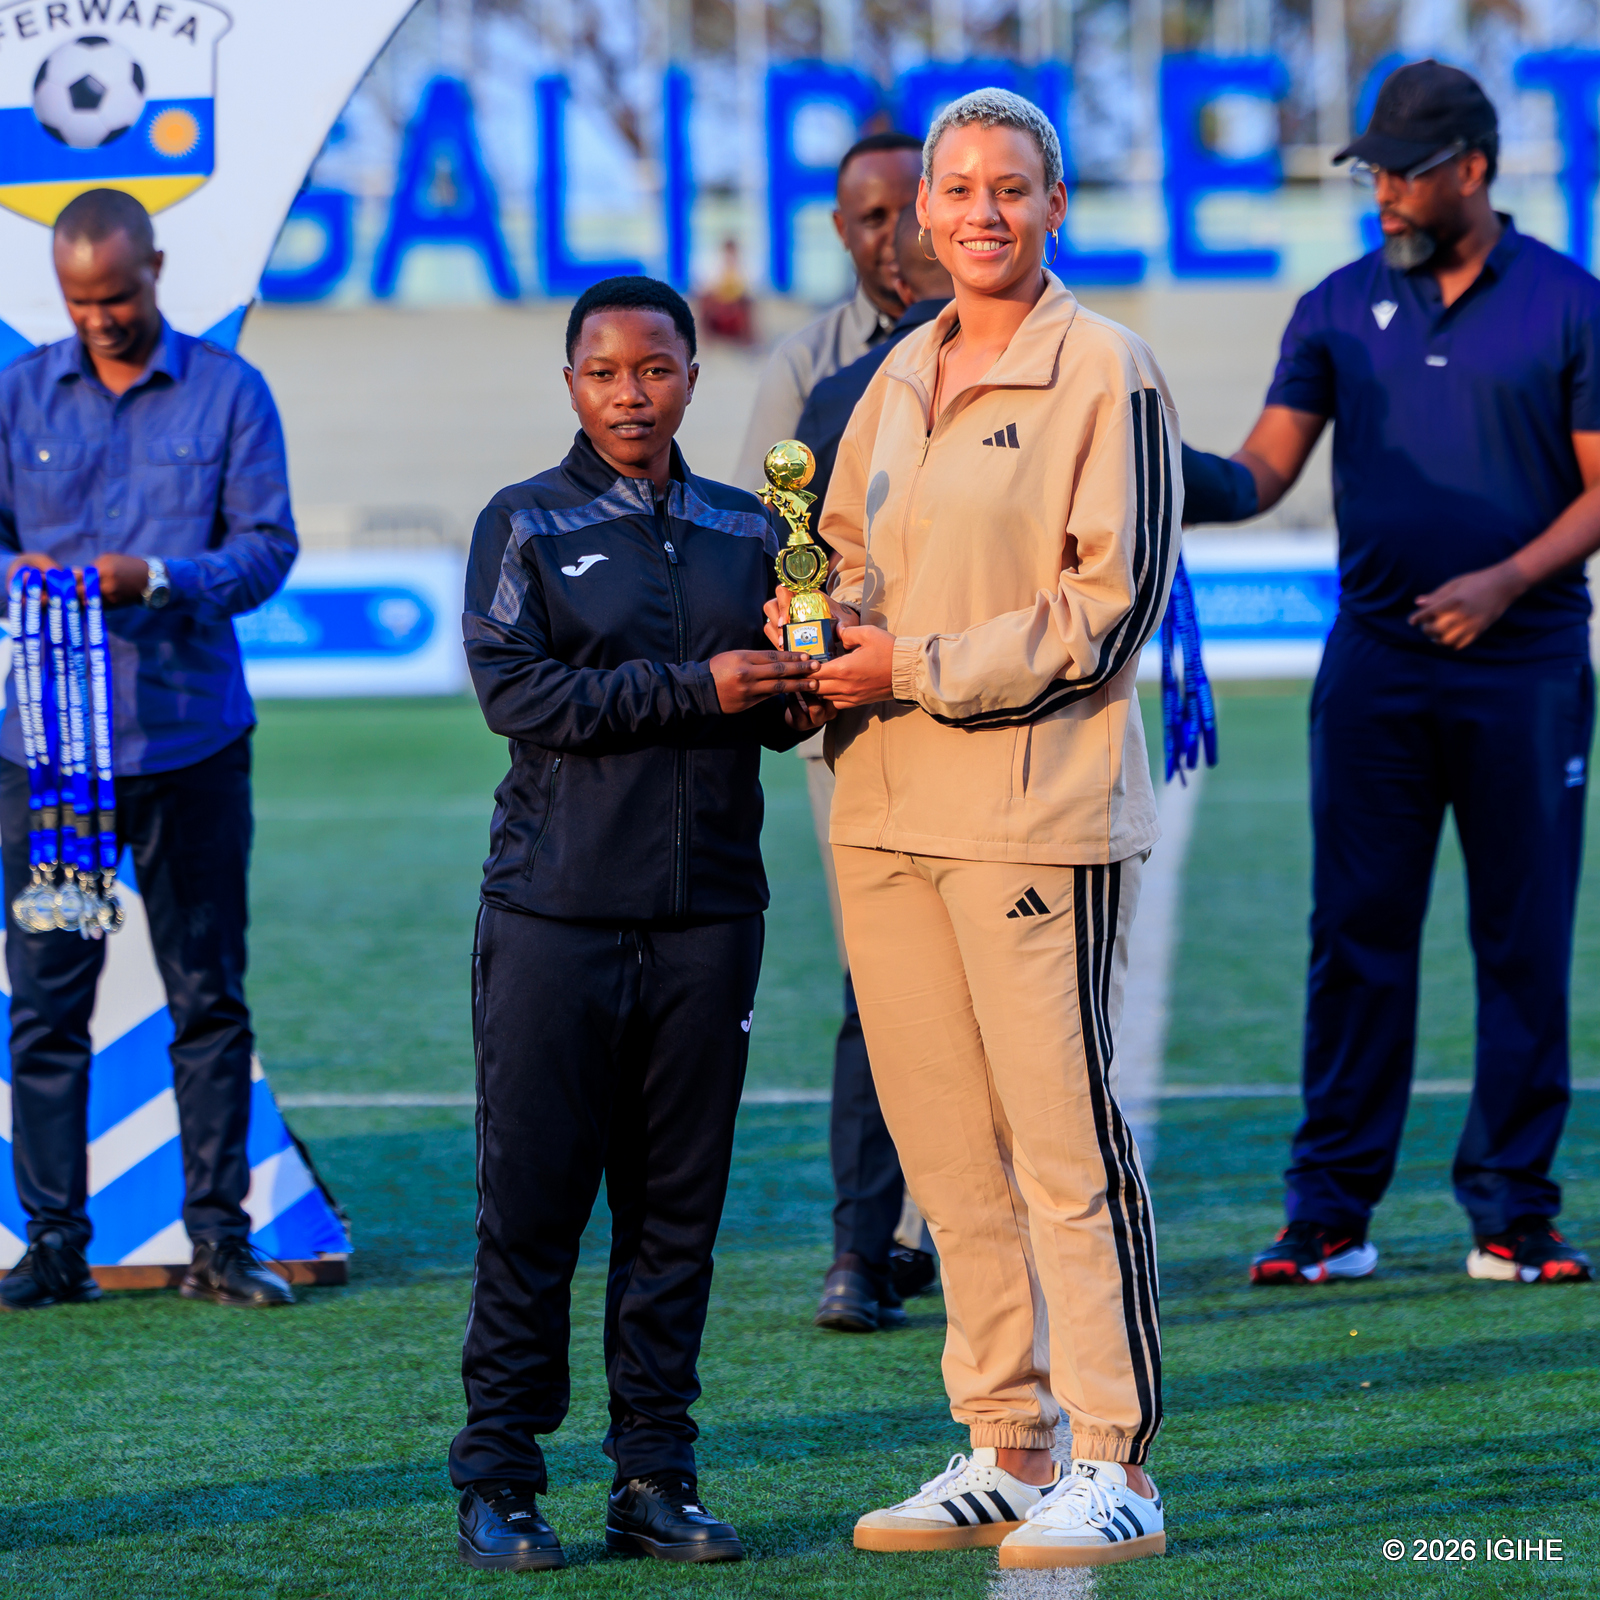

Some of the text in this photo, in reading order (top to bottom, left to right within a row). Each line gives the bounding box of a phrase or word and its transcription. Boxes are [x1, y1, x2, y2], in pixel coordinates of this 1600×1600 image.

[0, 0, 197, 46] ERWAFA
[26, 599, 40, 635] RWANDA
[49, 609, 62, 644] RWANDA
[88, 609, 104, 646] RWANDA
[28, 666, 42, 701] PREMIER
[91, 675, 108, 713] PREMIER
[30, 702, 45, 734] LEAGUE
[93, 714, 110, 746] LEAGUE
